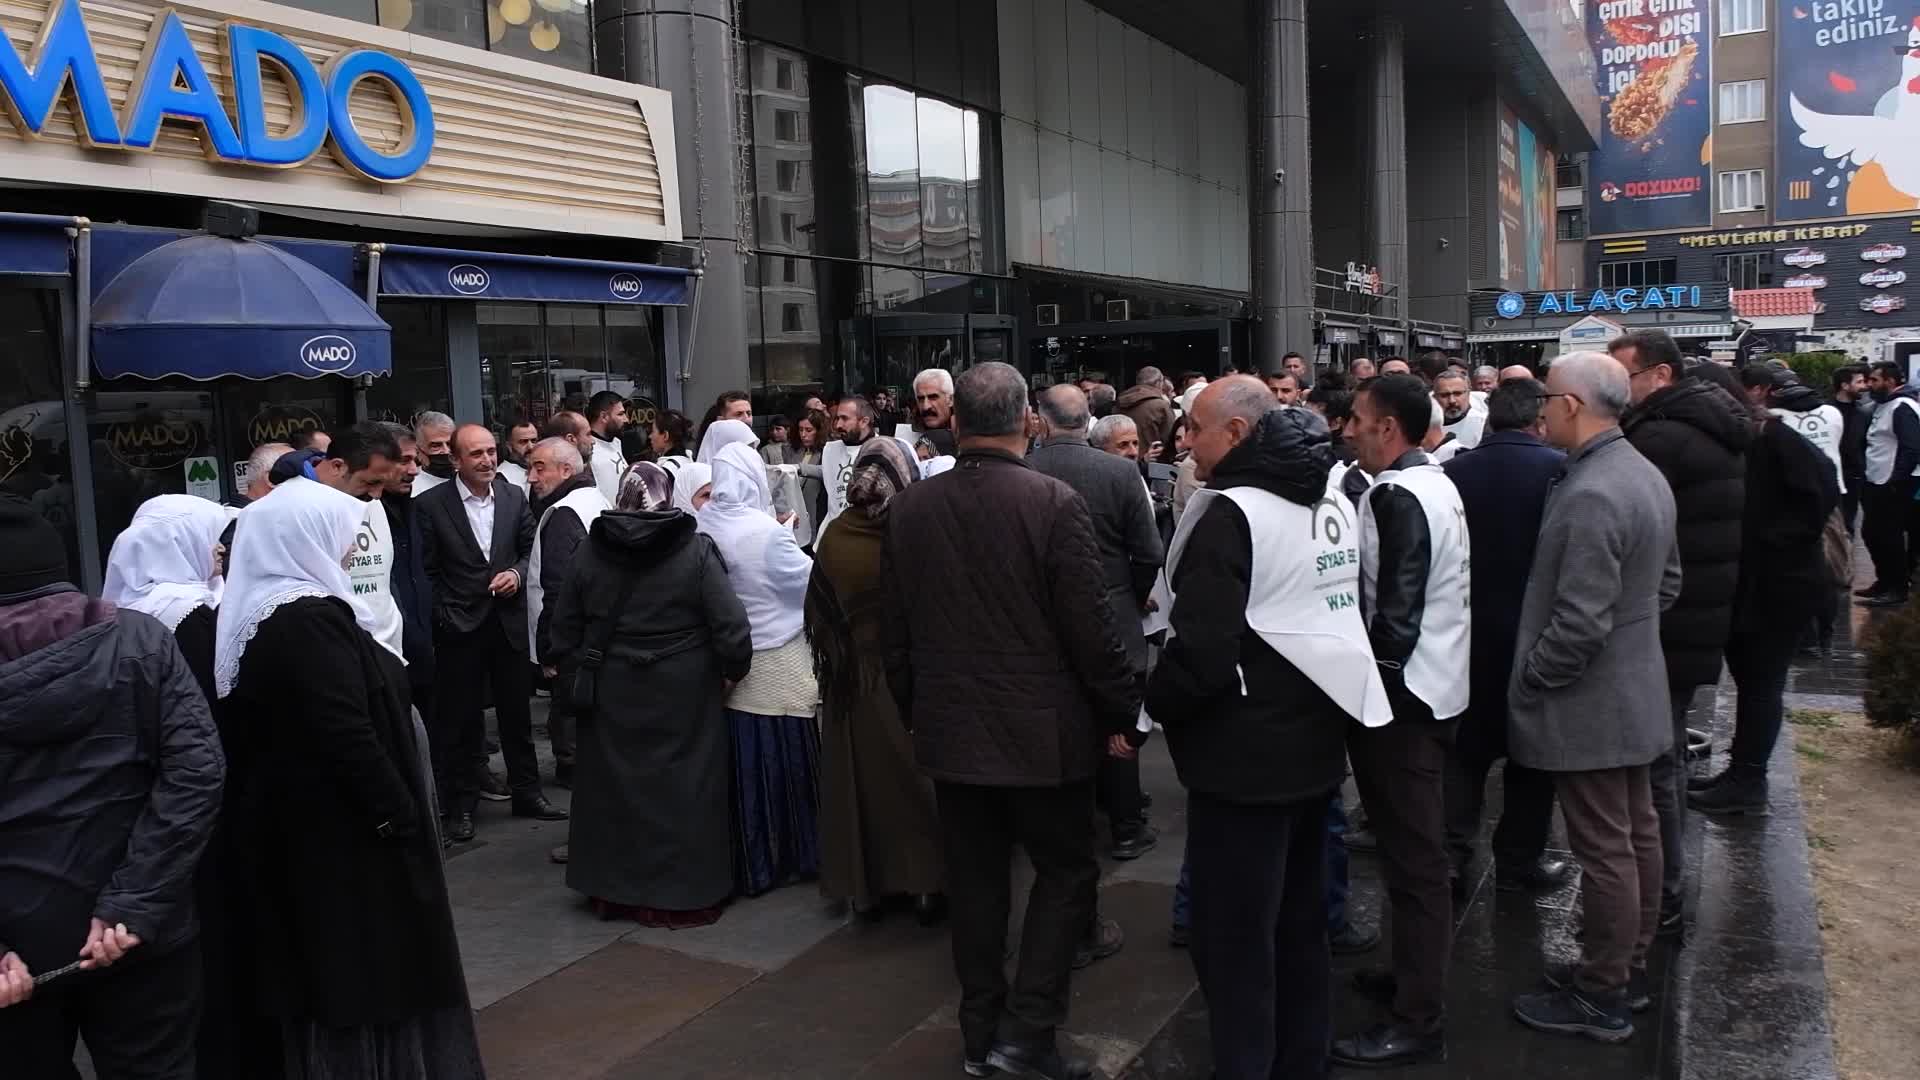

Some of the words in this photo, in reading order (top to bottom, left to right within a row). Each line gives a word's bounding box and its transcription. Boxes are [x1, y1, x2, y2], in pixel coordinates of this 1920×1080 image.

[1815, 13, 1908, 47] ediniz.
[1601, 40, 1681, 65] DOPDOLU
[0, 0, 436, 181] MADO
[1689, 229, 1787, 247] MEVLANA
[1794, 224, 1869, 240] KEBAP
[453, 273, 485, 286] MADO
[613, 280, 639, 292] MADO
[1538, 286, 1701, 313] ALAÇATI
[308, 346, 351, 362] MADO
[625, 408, 656, 425] ADO
[114, 422, 190, 448] MADO
[353, 582, 378, 596] WAN
[1326, 592, 1356, 611] WAN
